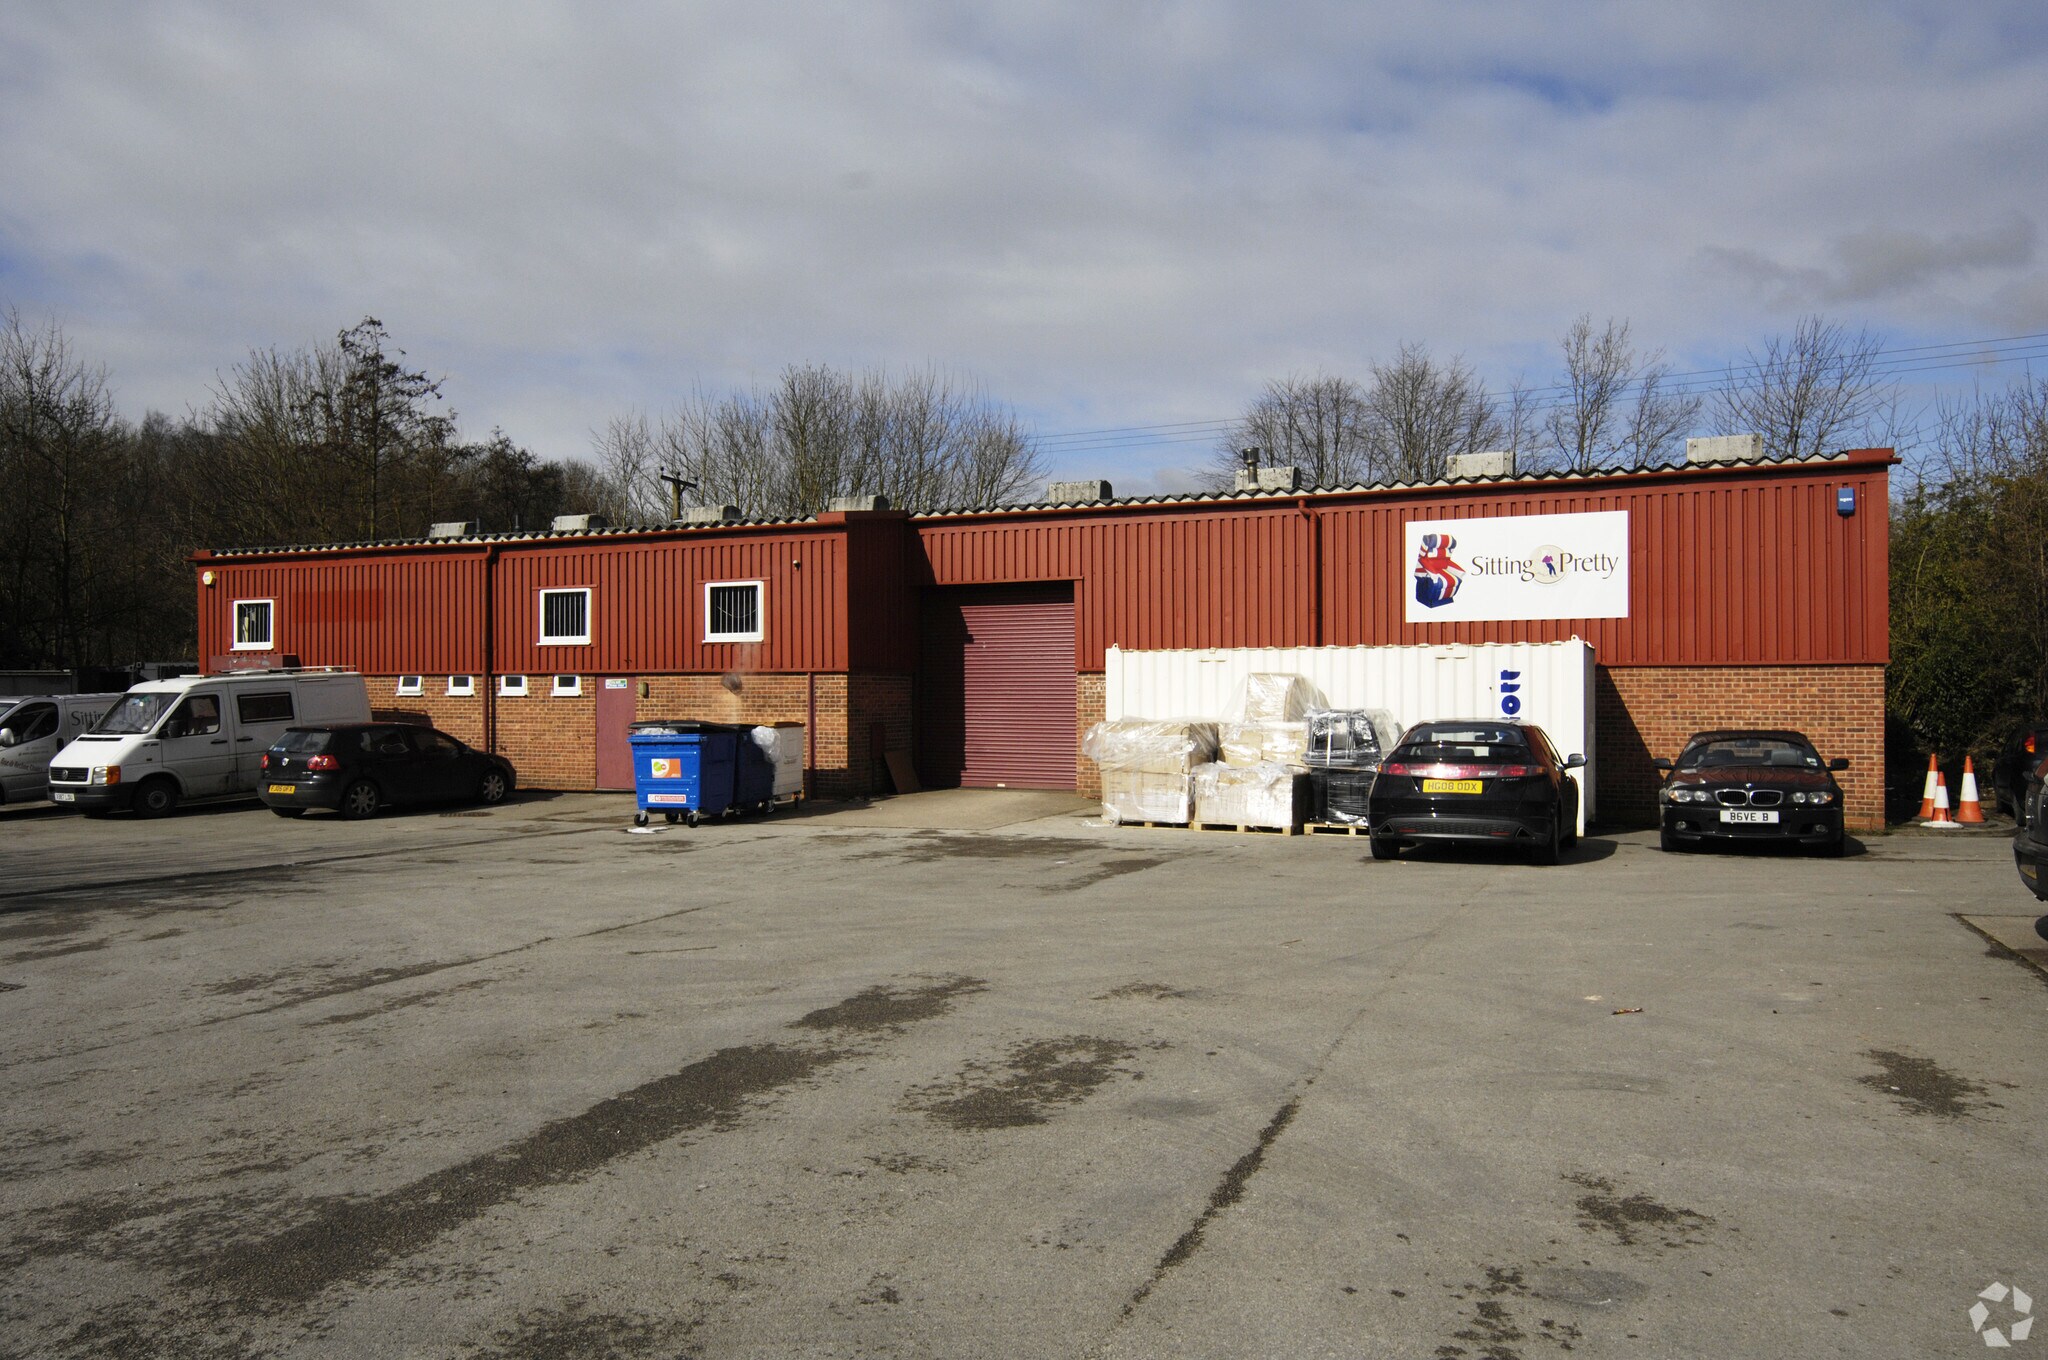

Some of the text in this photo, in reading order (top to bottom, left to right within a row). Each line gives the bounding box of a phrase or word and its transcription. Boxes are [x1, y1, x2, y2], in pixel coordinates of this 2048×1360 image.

[1471, 552, 1619, 582] Sitting Pretty
[1427, 780, 1477, 791] HG08 ODX
[1730, 812, 1769, 821] B6VE B
